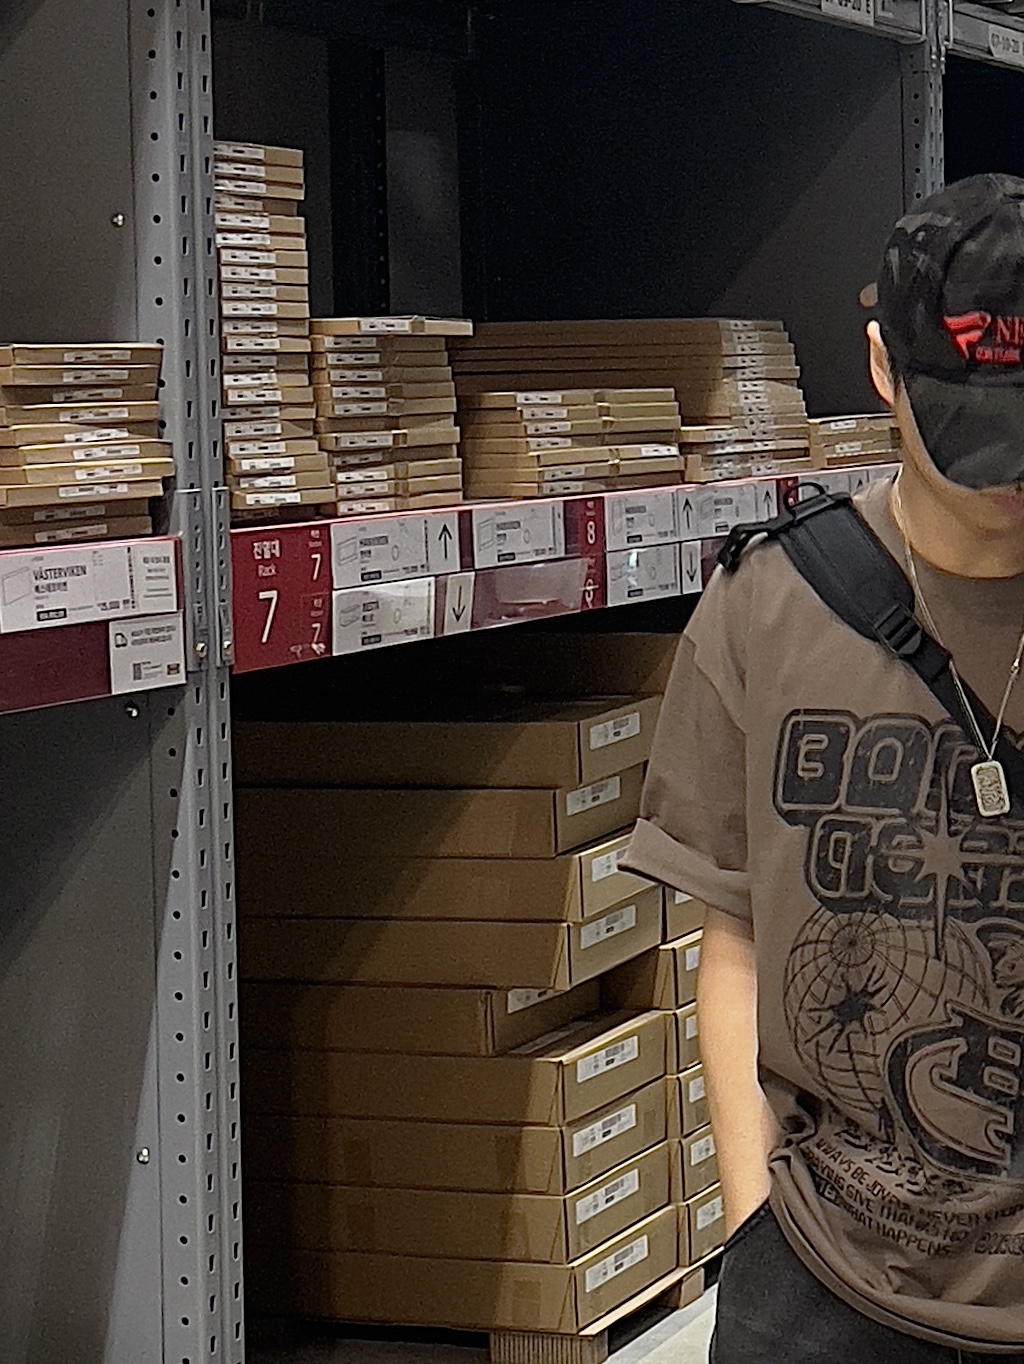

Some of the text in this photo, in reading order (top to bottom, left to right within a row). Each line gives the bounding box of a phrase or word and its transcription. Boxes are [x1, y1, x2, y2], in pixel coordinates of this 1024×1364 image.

[587, 520, 596, 544] 8
[253, 539, 281, 560] 진열대
[258, 563, 277, 577] Rack
[310, 553, 321, 580] 7
[258, 590, 278, 643] 7
